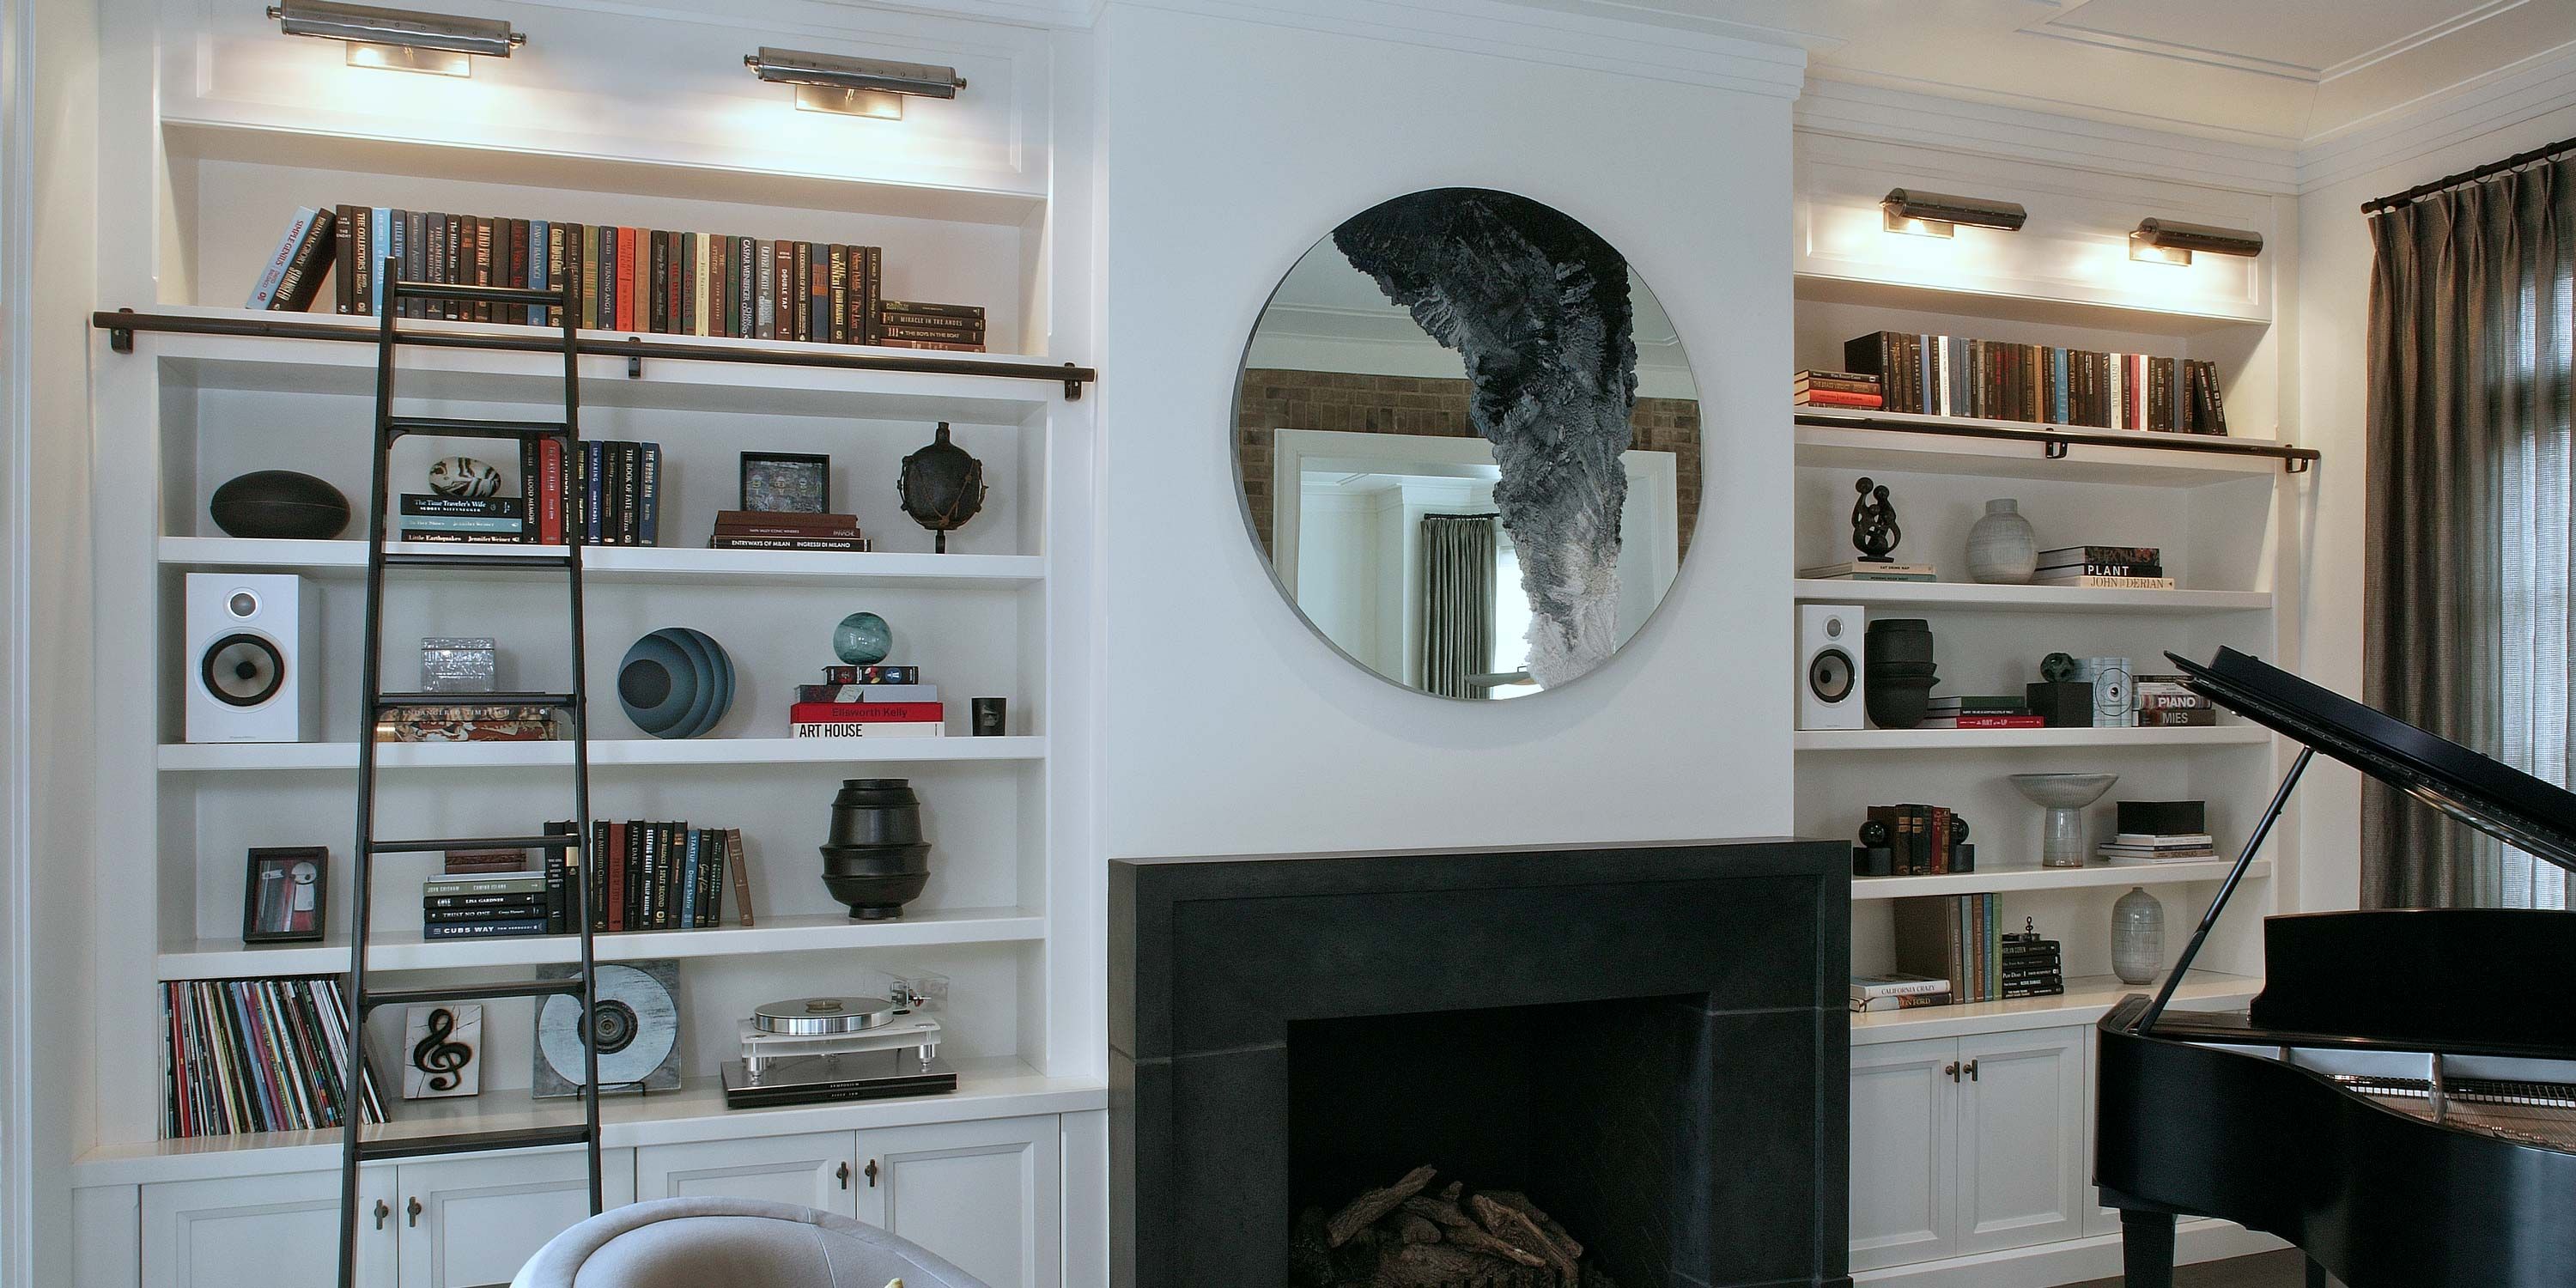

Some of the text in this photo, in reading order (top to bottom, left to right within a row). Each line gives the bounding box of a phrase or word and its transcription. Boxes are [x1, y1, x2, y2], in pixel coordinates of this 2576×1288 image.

[312, 216, 326, 236] BRIAN
[276, 220, 303, 266] SIMPLE GENIUS
[357, 228, 366, 270] COLLECTORS
[477, 226, 490, 267] MIND PREY
[761, 246, 770, 290] OLIVER NORTH
[831, 252, 841, 286] WINNER
[851, 301, 861, 329] The Lion
[644, 451, 654, 498] THE WRONG MAN
[626, 484, 632, 493] OF
[2088, 565, 2129, 575] PLANT
[2091, 577, 2164, 588] JOHN DERIAN
[2158, 697, 2196, 707] PIANO
[832, 708, 908, 718] Ellsworth Kelly
[2163, 713, 2188, 724] MIES
[799, 724, 863, 738] ART HOUSE
